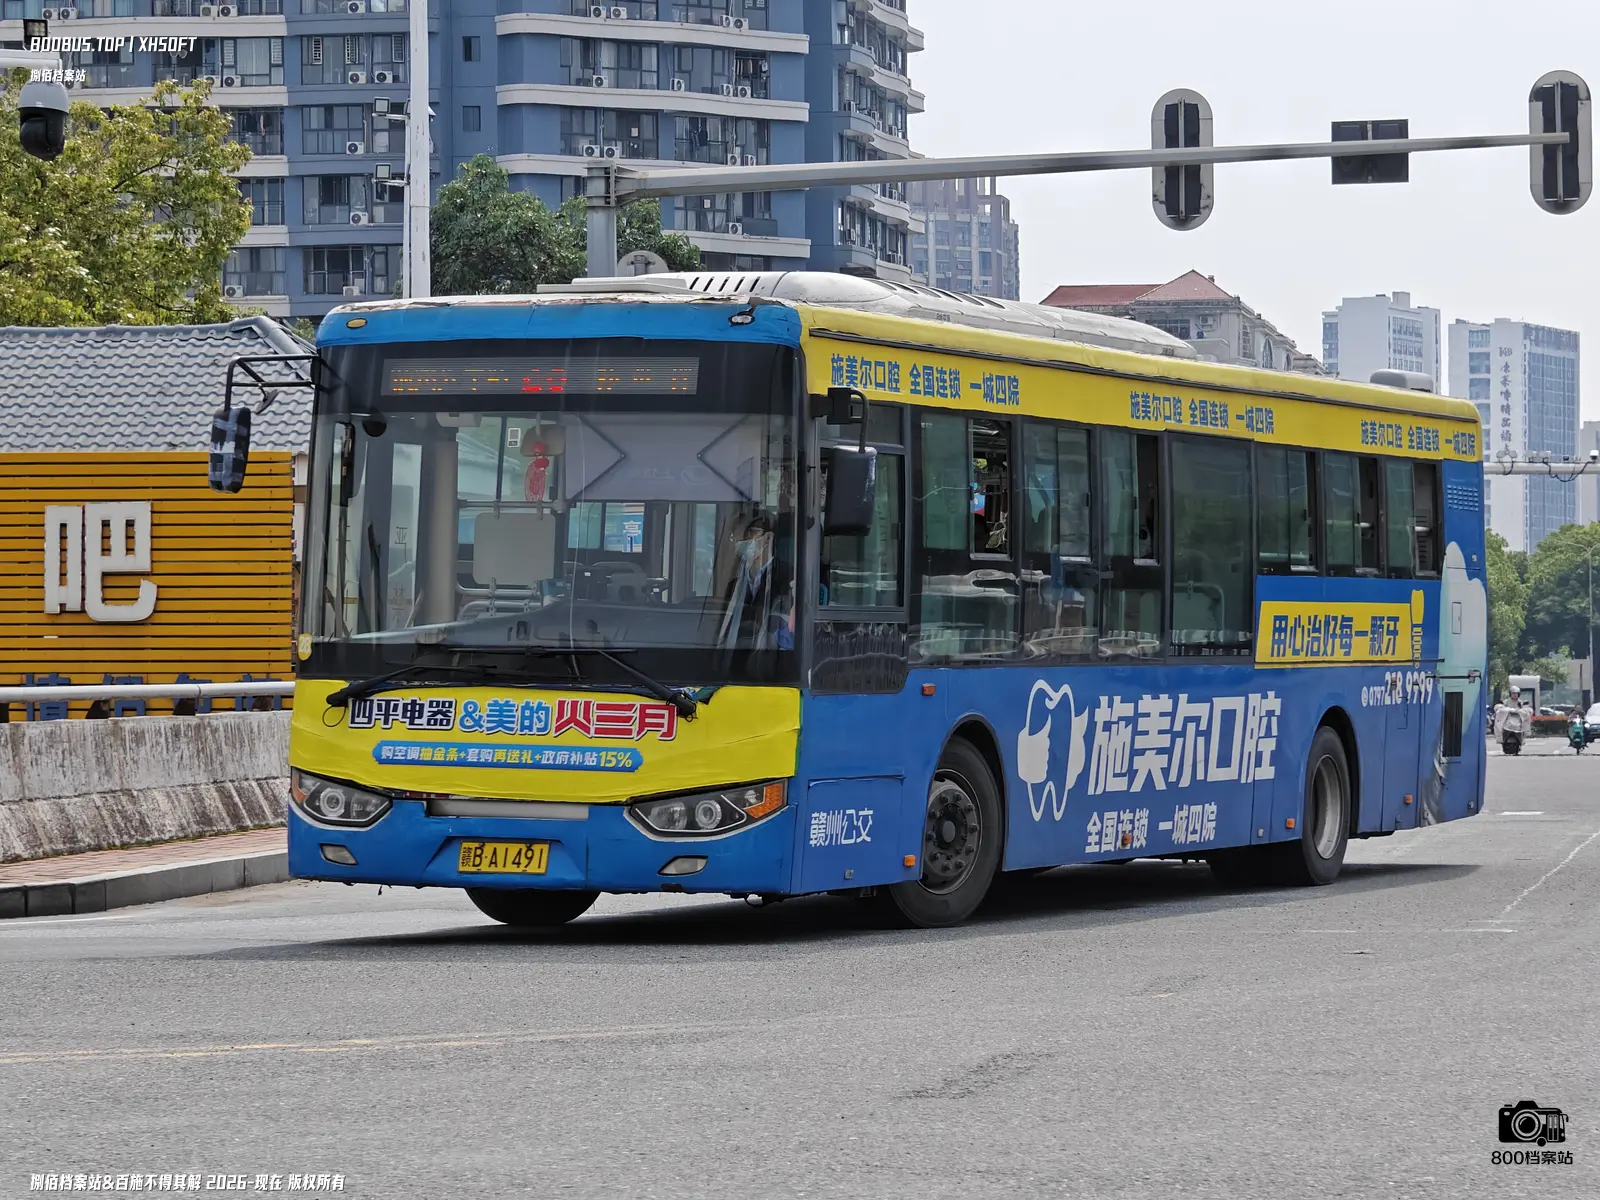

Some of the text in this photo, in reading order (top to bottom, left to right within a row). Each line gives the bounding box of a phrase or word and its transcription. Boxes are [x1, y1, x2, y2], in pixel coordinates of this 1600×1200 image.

[830, 353, 1020, 406] 施美尔口腔 全国连锁 一城四院
[1130, 391, 1275, 435] 施美尔口腔 全国连锁 一城四院
[1360, 419, 1476, 457] 施美尔口腔 全国连锁 一城四院
[44, 501, 158, 623] 吧
[1270, 614, 1400, 658] 用心治好每一颗牙
[1087, 690, 1282, 796] 施美尔口腔
[809, 807, 874, 847] 赣州公交
[1084, 801, 1218, 854] 全国连锁 一城四院
